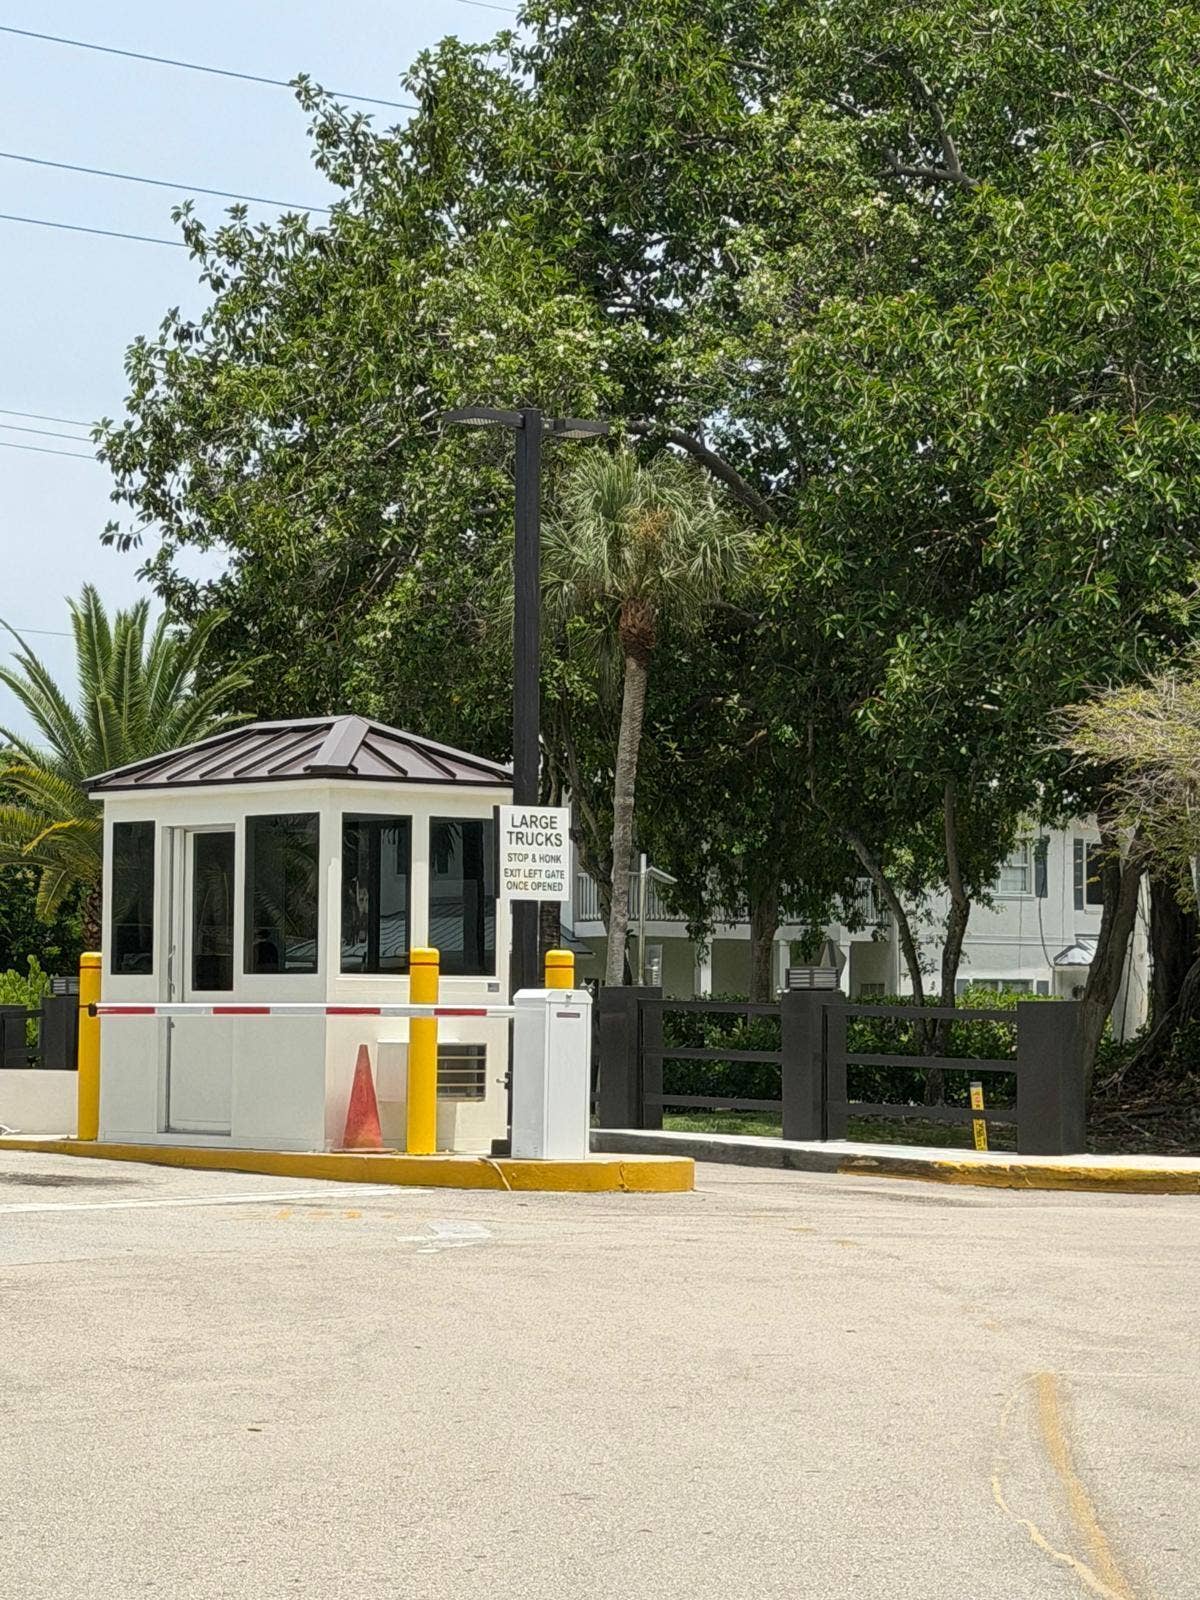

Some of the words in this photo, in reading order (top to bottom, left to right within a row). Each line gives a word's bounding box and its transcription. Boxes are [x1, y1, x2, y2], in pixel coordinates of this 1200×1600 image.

[511, 814, 558, 830] LARGE
[506, 830, 563, 847] TRUCKS
[507, 852, 529, 863] STOP
[531, 853, 537, 863] &
[539, 854, 562, 864] HONK
[503, 868, 521, 878] EXIT
[523, 869, 542, 878] LEFT
[544, 870, 565, 880] GATE
[506, 881, 529, 891] ONCE
[530, 881, 563, 892] OPENED
